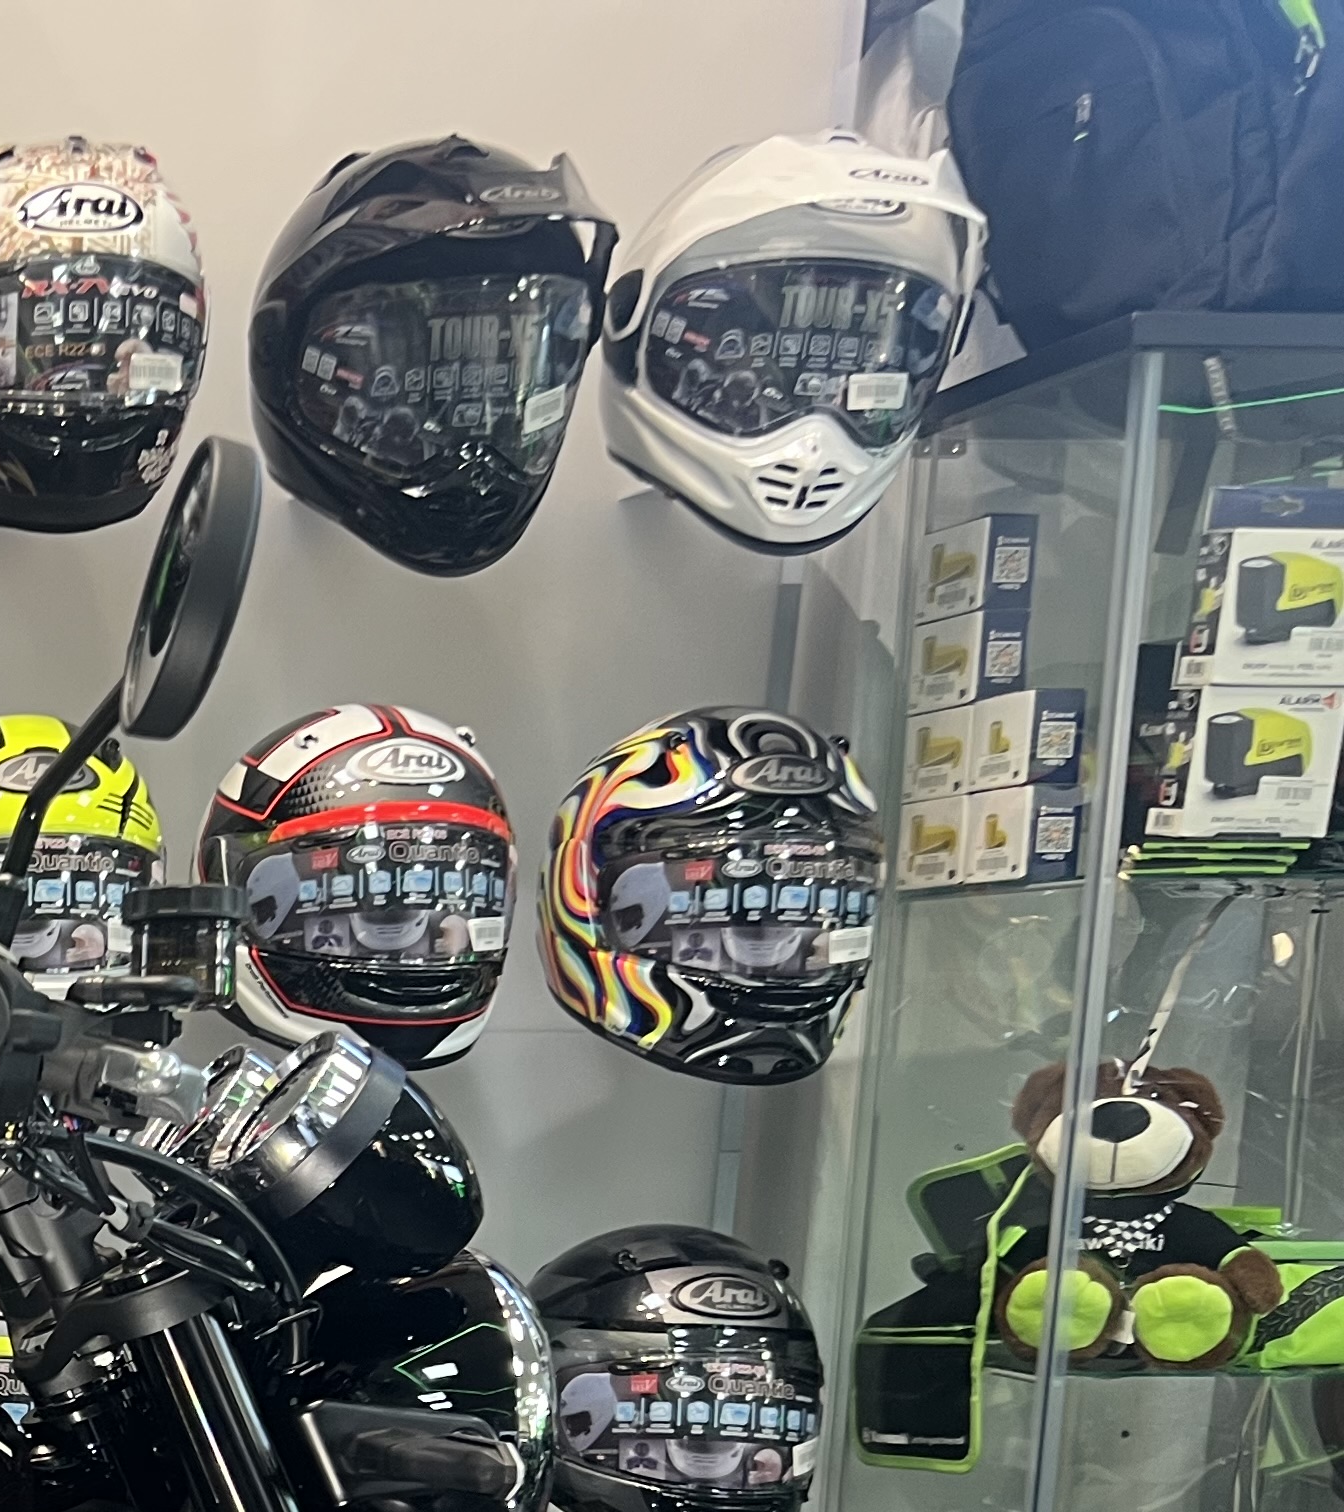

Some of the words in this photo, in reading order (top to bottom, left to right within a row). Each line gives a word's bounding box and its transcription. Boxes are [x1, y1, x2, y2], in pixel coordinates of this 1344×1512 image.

[44, 188, 130, 220] Arai
[782, 285, 895, 328] TOUR-X5
[378, 748, 444, 770] Arai
[752, 759, 824, 784] Arai
